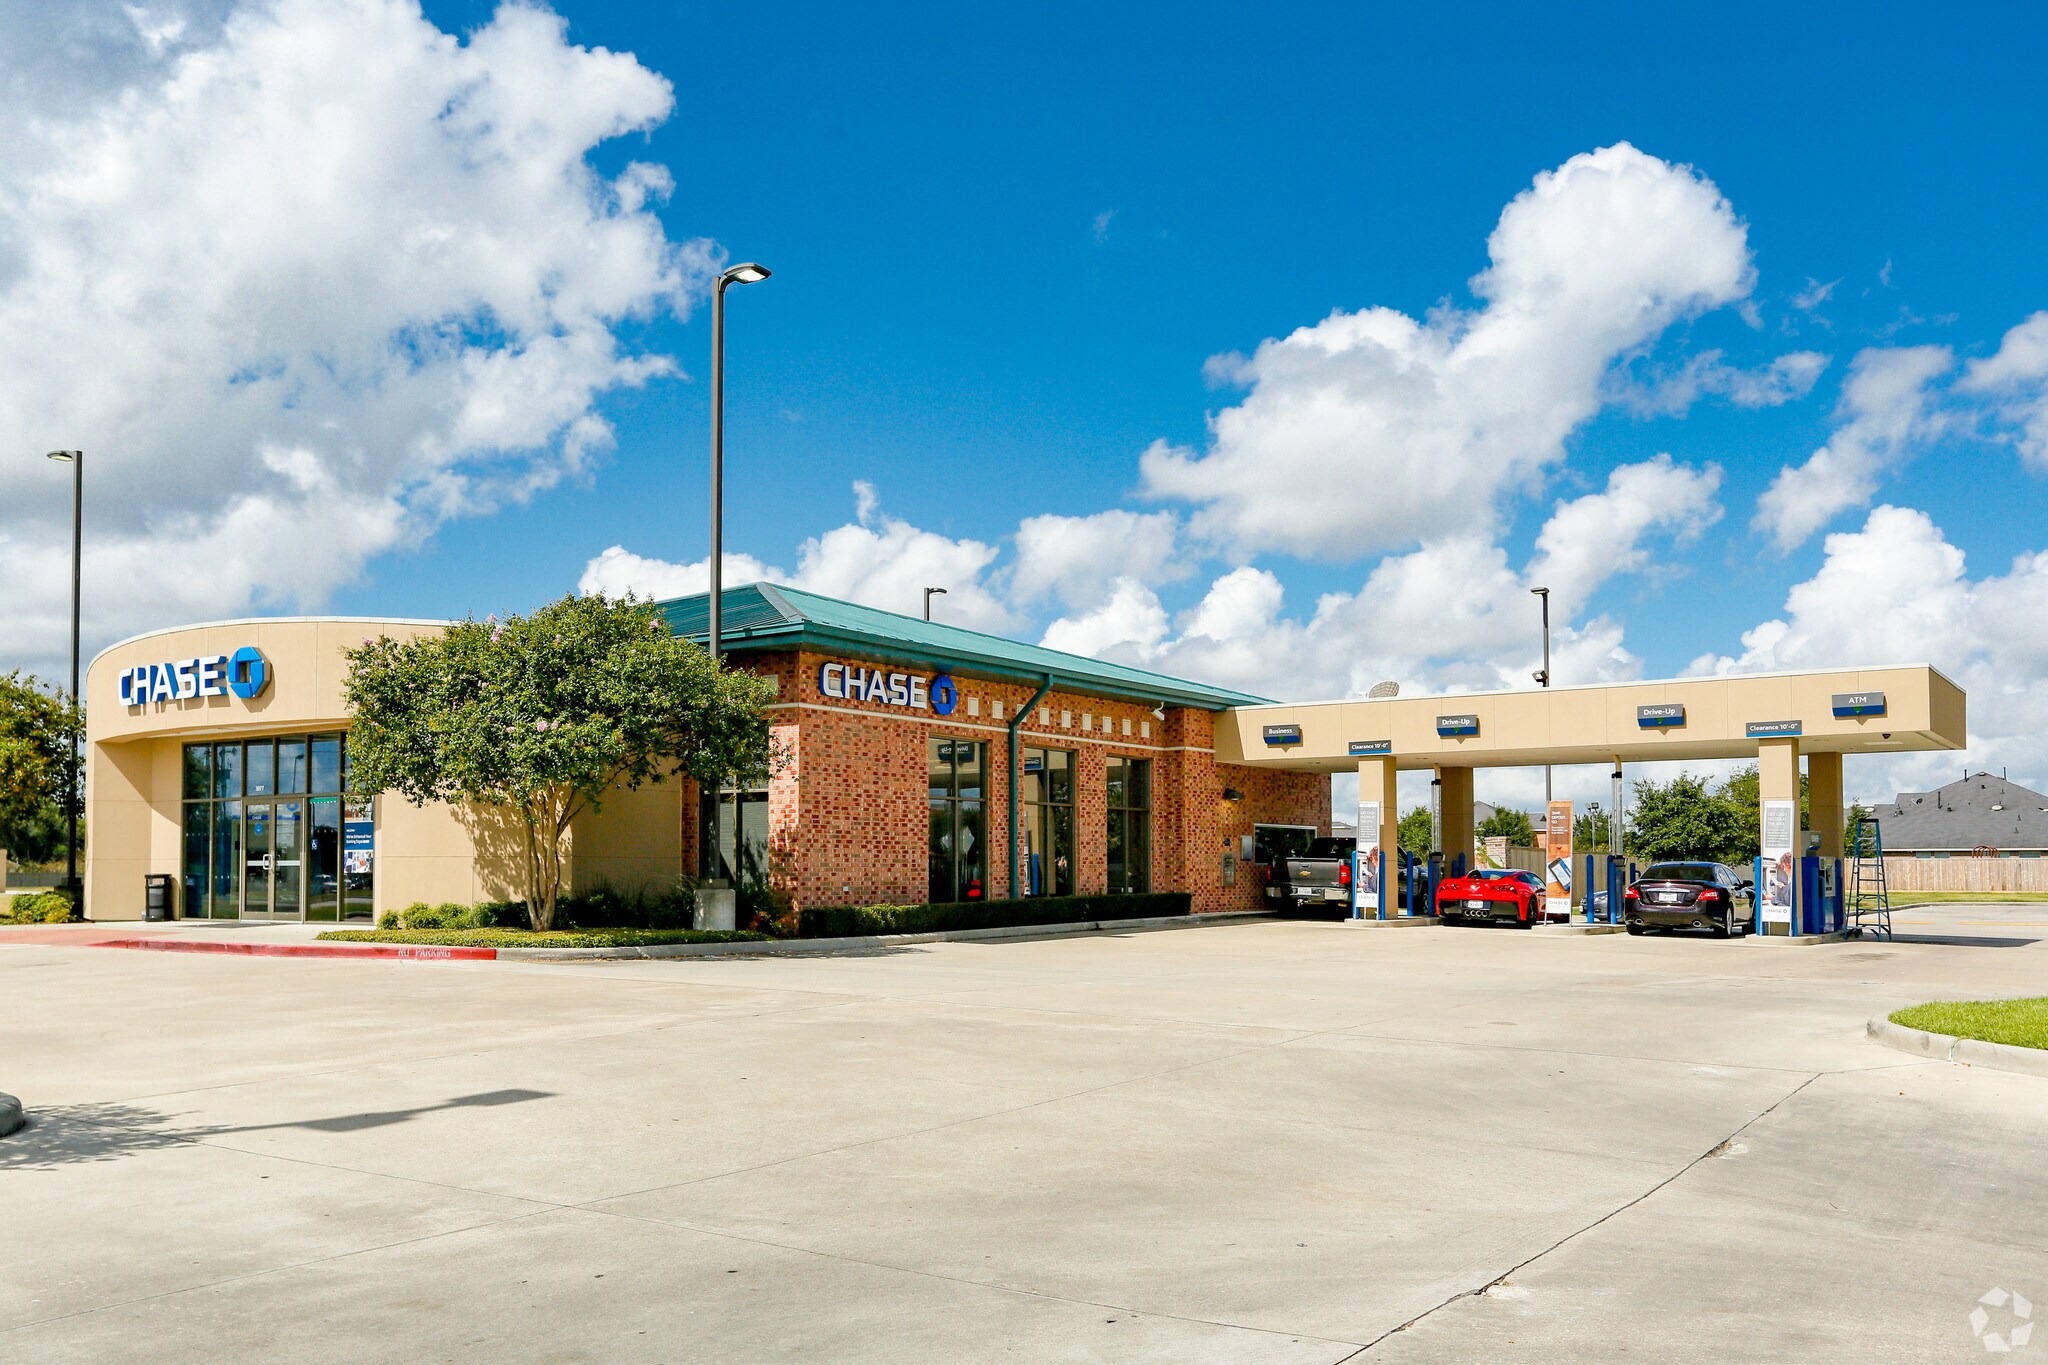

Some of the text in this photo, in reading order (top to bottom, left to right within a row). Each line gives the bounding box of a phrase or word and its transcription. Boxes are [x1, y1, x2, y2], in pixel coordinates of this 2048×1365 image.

[118, 656, 228, 706] CHASE
[820, 663, 928, 709] CHASE
[1848, 696, 1867, 704] ATM
[1643, 708, 1676, 716] Drive-Up
[1268, 727, 1293, 735] Business
[415, 948, 451, 958] PARKING
